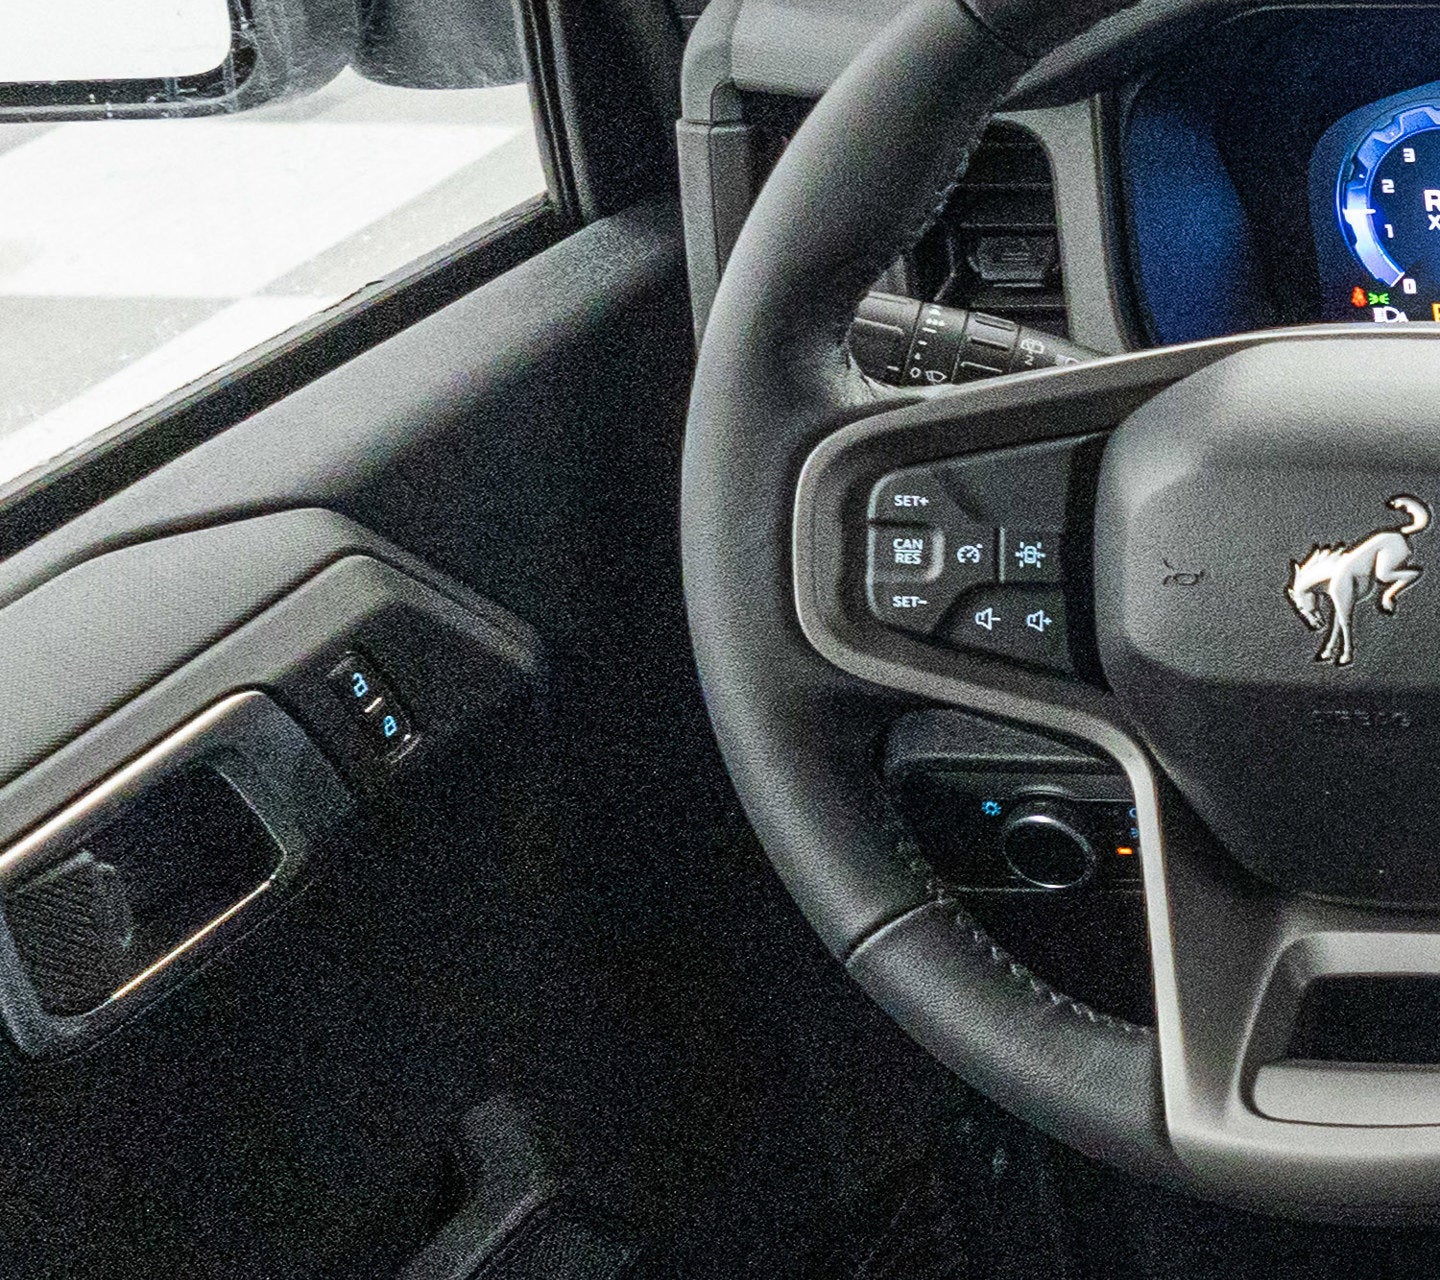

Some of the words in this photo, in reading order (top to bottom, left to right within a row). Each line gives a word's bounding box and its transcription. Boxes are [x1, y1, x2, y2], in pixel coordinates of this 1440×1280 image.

[1403, 148, 1416, 163] 3
[1381, 179, 1395, 194] 2
[1384, 224, 1394, 239] 1
[1402, 279, 1417, 295] 0
[894, 494, 930, 507] SET+
[892, 538, 924, 551] CAN
[894, 552, 923, 565] RES
